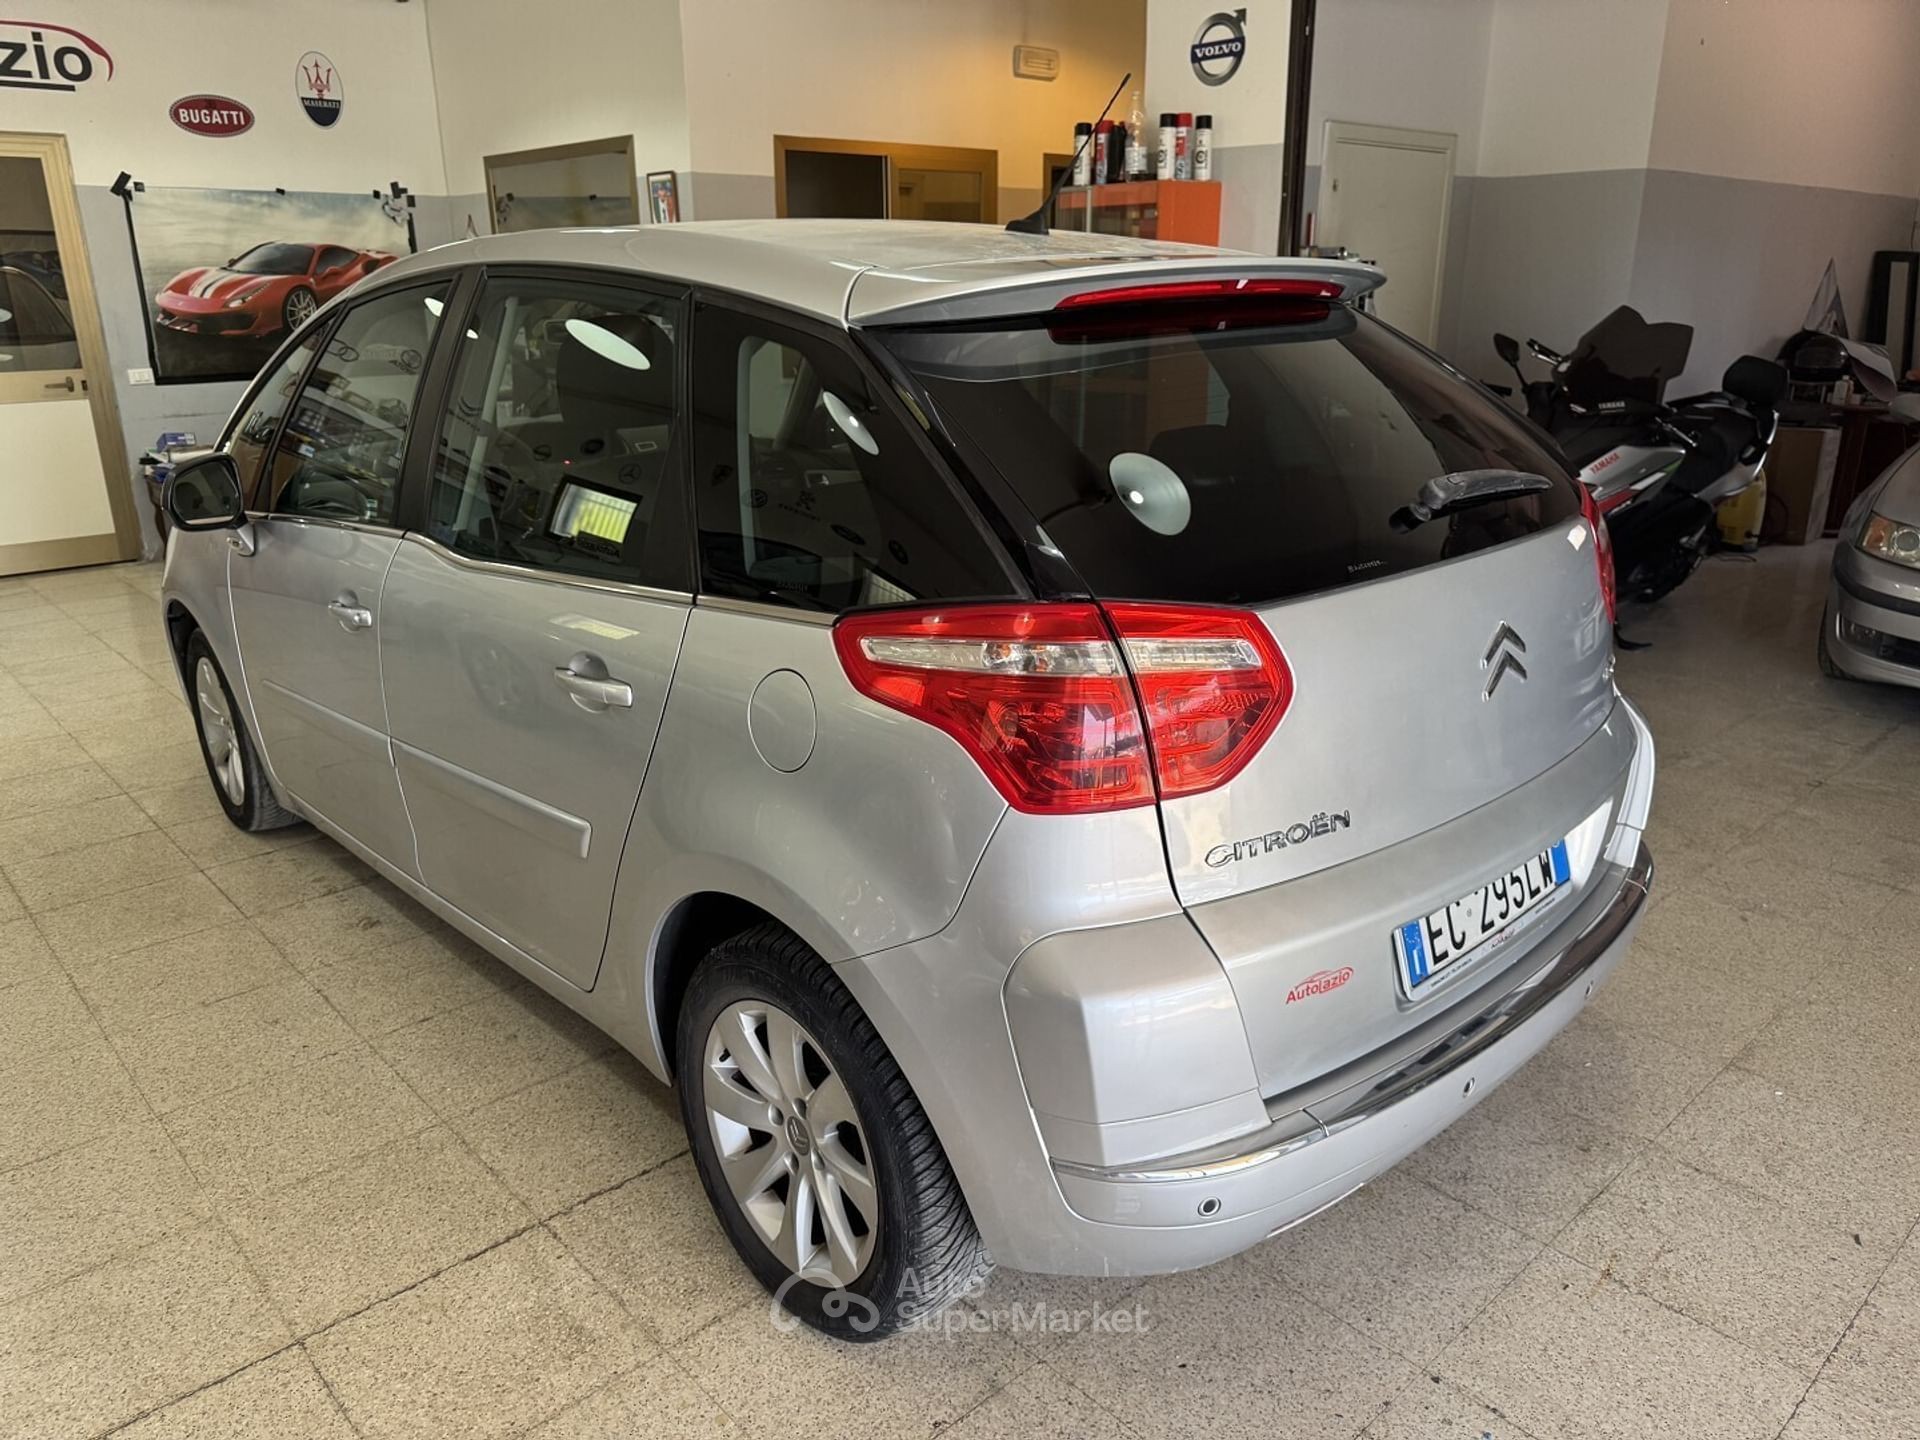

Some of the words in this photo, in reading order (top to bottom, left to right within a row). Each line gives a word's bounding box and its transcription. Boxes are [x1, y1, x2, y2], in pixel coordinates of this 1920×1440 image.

[1195, 42, 1242, 58] VOLVO
[179, 108, 246, 126] BUGATTI
[1204, 809, 1351, 868] CITROËN
[1426, 900, 1466, 966] EC
[1285, 970, 1351, 1006] Autolazio
